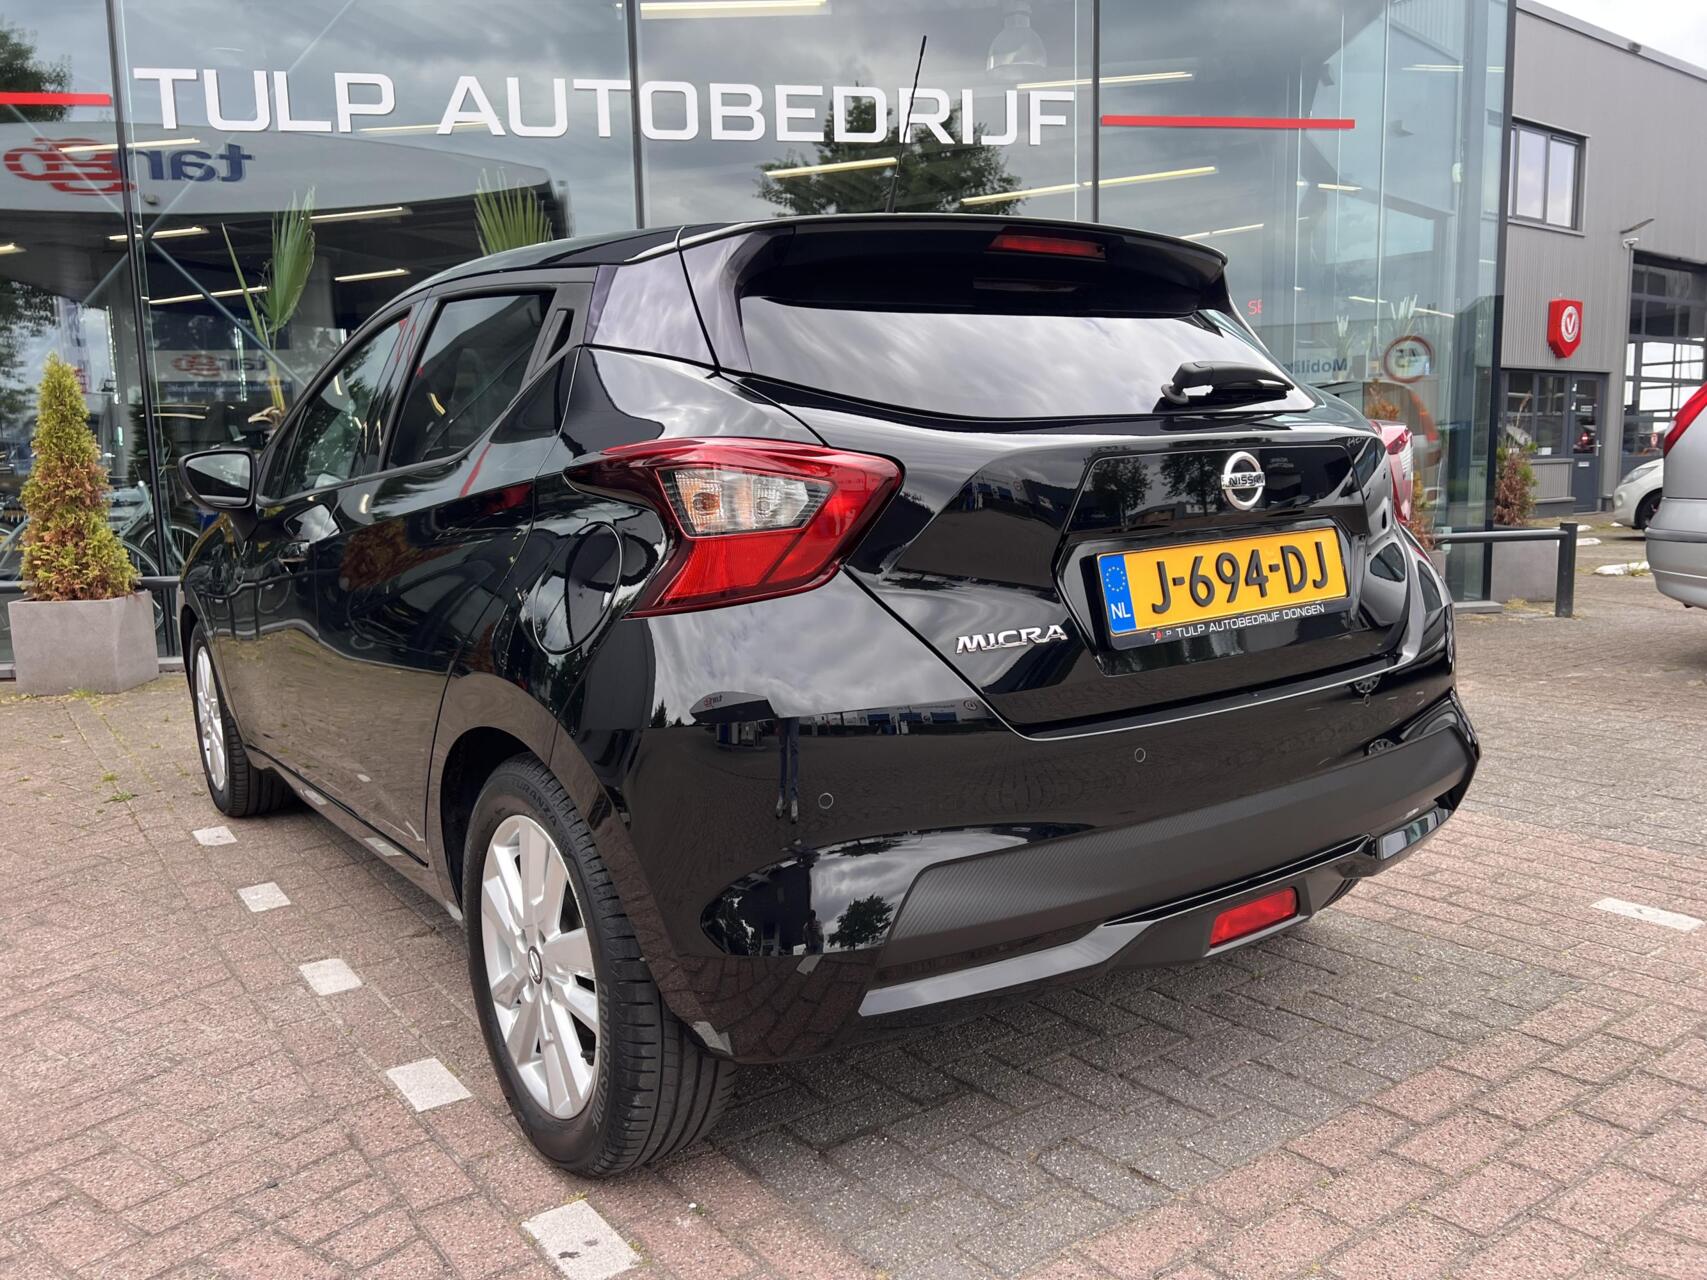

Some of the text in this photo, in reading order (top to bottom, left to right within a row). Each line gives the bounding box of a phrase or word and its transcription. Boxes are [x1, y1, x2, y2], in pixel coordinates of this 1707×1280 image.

[133, 67, 1075, 147] TULP AUTOBEDRIJF
[1228, 473, 1264, 487] NISSAN
[1151, 541, 1329, 615] J-694-DJ
[1110, 602, 1132, 620] NL
[1175, 624, 1206, 638] TULP
[1208, 611, 1281, 633] AUTOBEDRIJF
[1283, 603, 1326, 620] DONGEN
[956, 624, 1069, 654] MICRA
